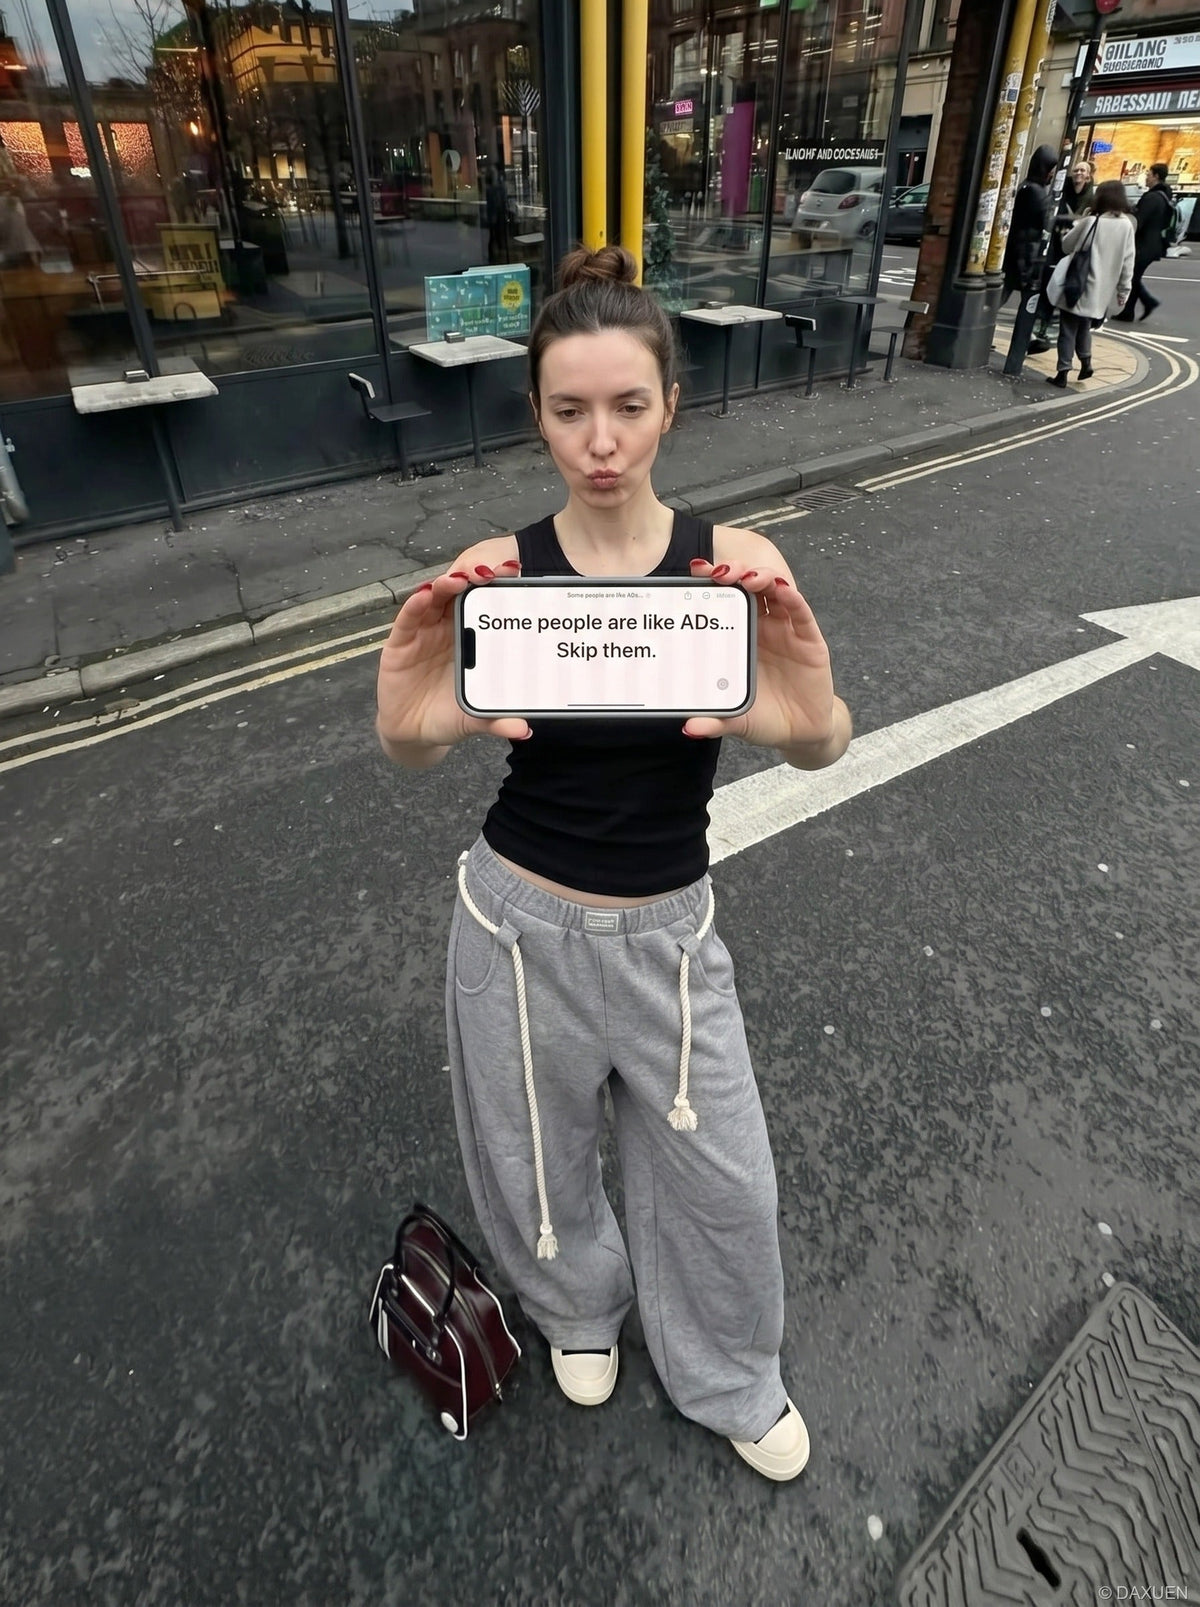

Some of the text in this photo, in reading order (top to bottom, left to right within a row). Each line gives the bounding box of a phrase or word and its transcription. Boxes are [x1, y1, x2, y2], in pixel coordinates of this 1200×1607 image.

[817, 148, 833, 160] AND
[478, 614, 734, 634] Some people are like ADs...
[557, 641, 656, 662] Skip them.
